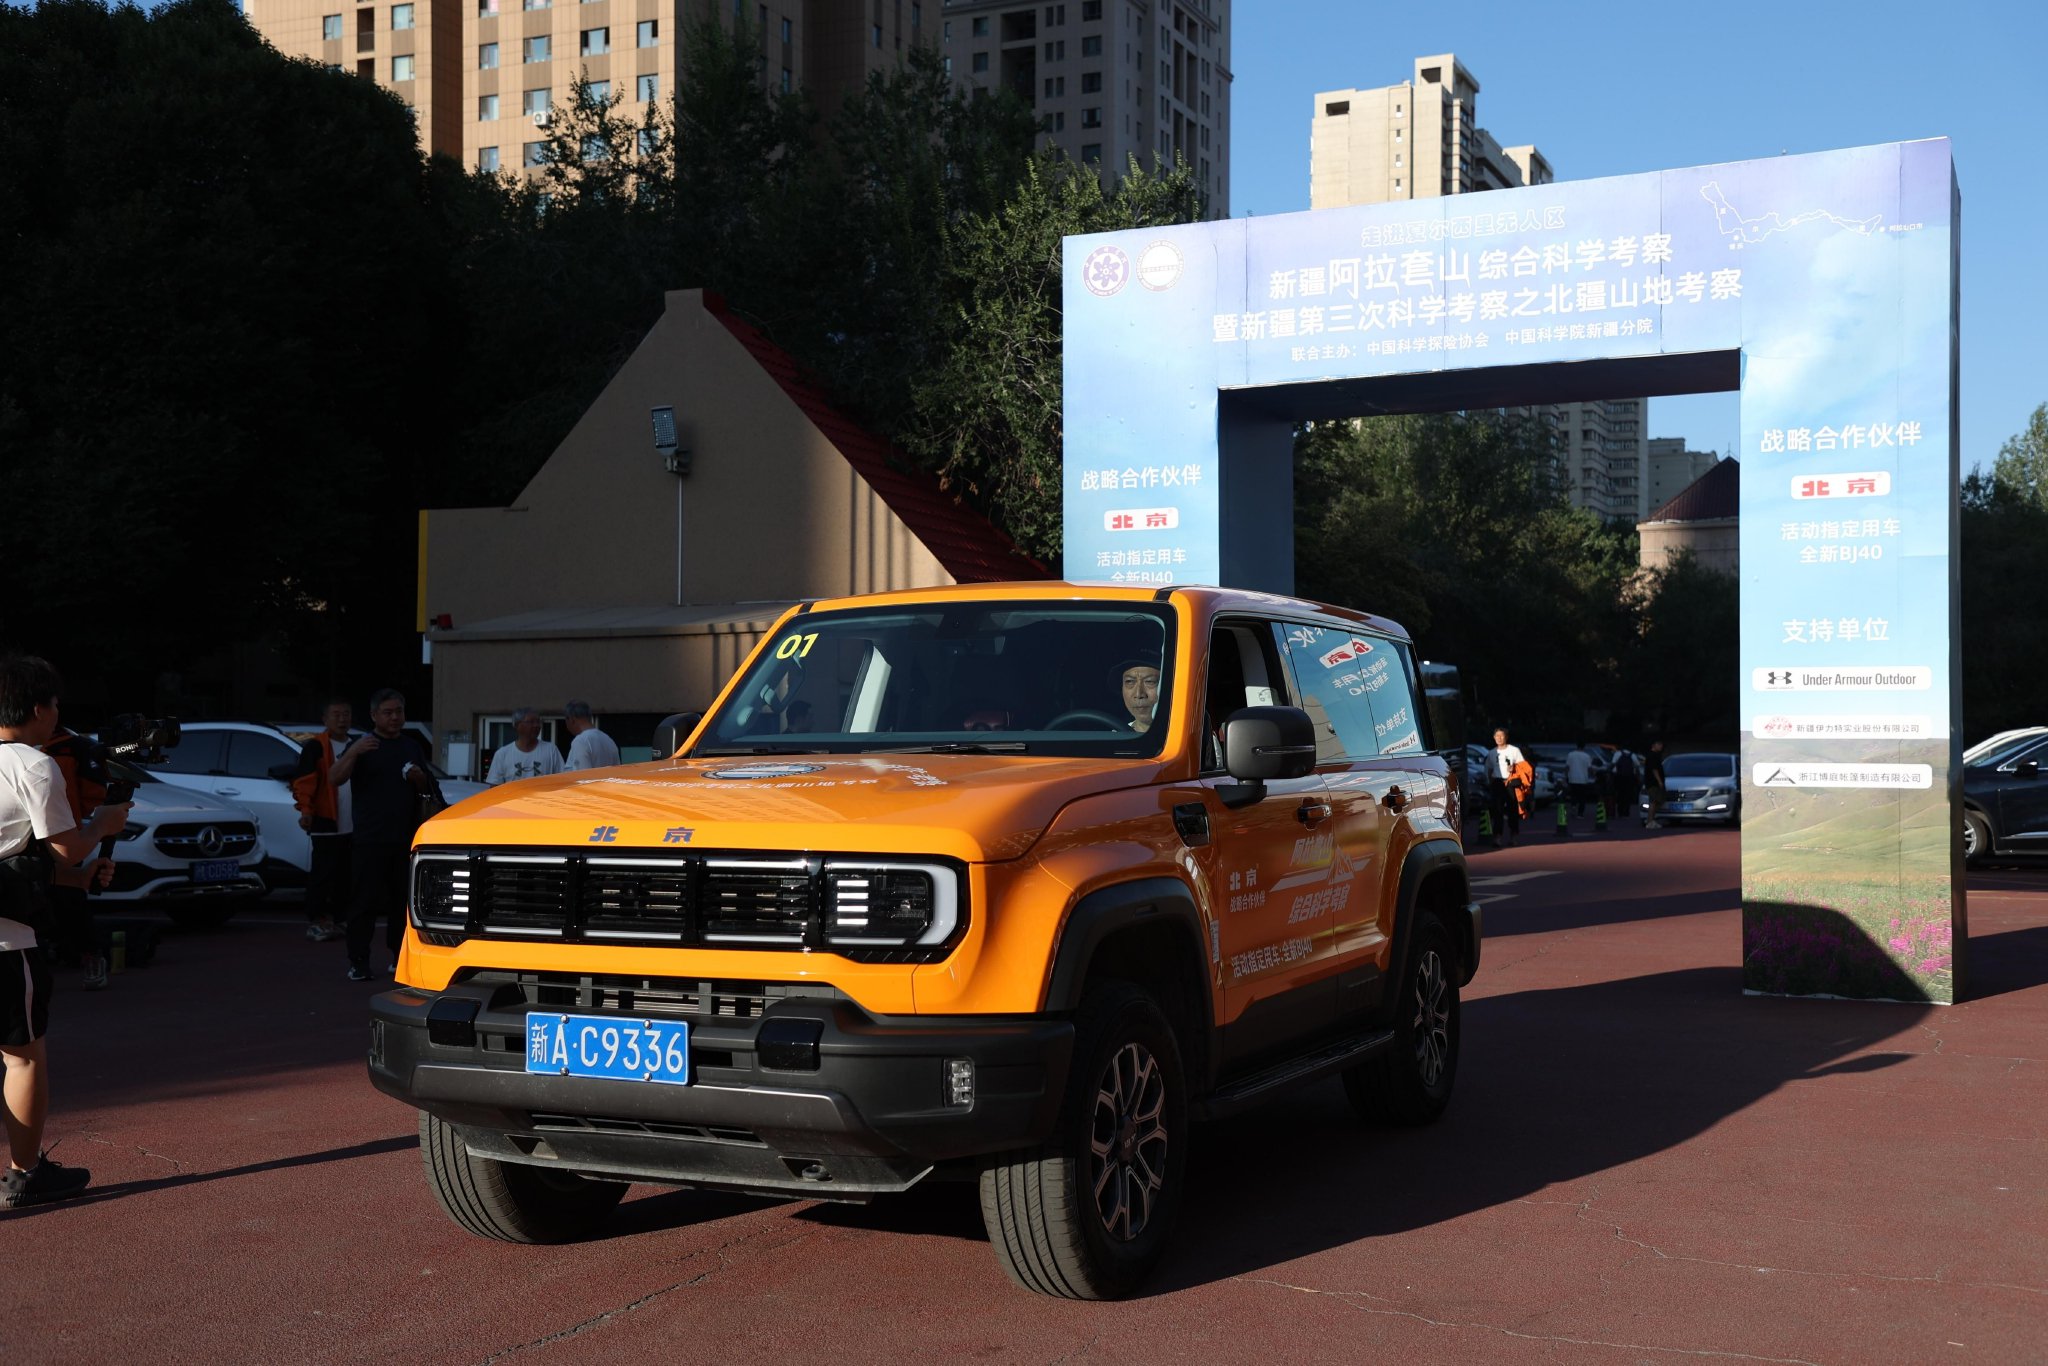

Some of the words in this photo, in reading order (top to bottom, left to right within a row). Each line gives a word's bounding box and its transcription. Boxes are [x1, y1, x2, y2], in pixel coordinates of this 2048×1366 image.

[1212, 267, 1743, 343] 暨新疆第三次科学考察之北疆山地考察
[1760, 420, 1923, 453] 战略合作伙伴
[1081, 464, 1202, 491] 战略合作伙伴
[1801, 478, 1876, 497] 北京
[1112, 513, 1168, 529] 北京
[1780, 518, 1901, 541] 活动指定用车
[1097, 547, 1187, 567] 活动指定用车
[1799, 544, 1883, 564] 全新BJ40
[1781, 616, 1890, 644] 支持单位
[776, 633, 819, 659] 01
[1802, 674, 1832, 686] Under
[1834, 673, 1872, 686] Armour
[1875, 672, 1917, 686] Outdoor
[115, 742, 139, 754] RONIN
[588, 826, 696, 843] 北京
[1230, 868, 1257, 891] 北京
